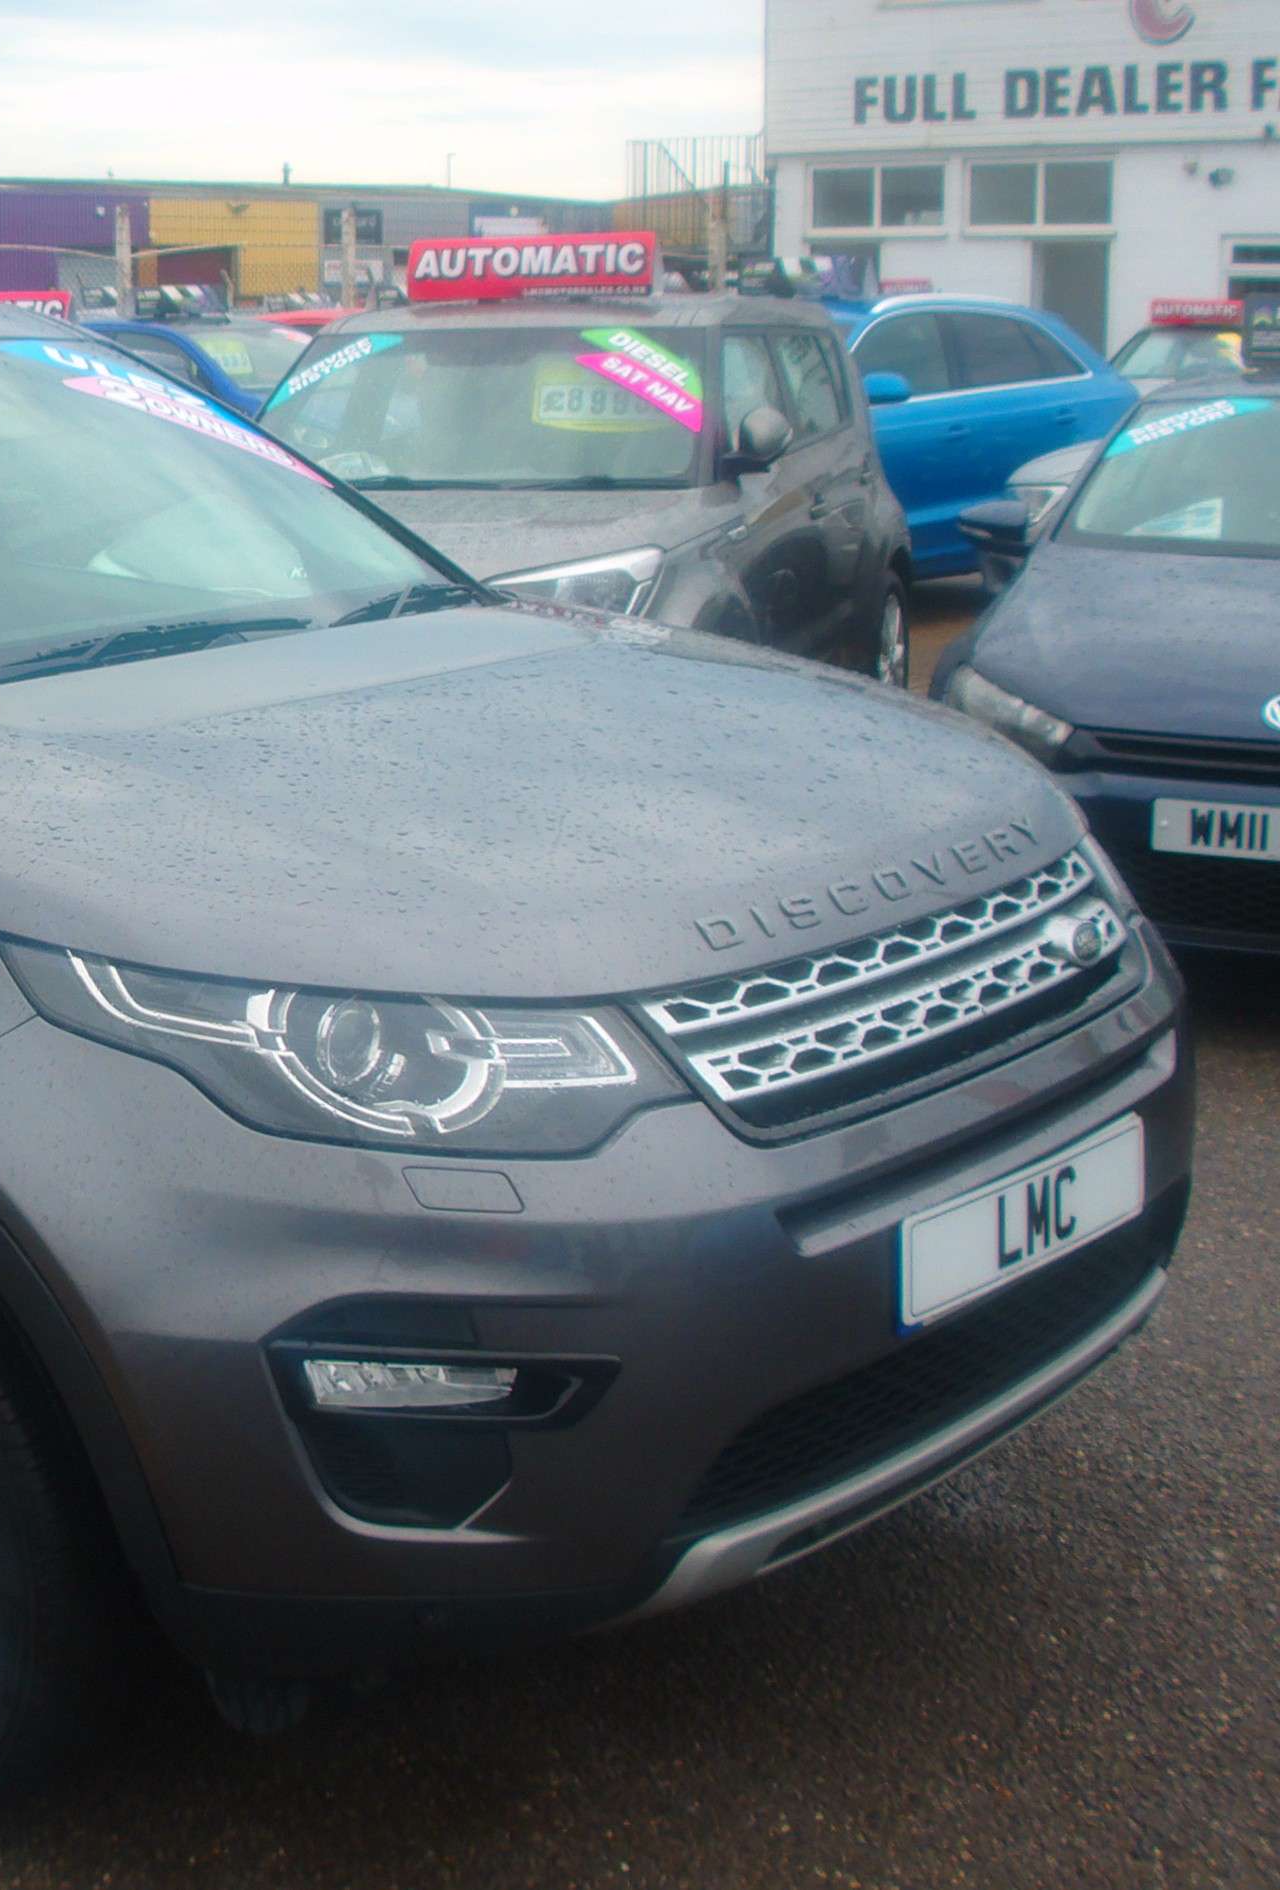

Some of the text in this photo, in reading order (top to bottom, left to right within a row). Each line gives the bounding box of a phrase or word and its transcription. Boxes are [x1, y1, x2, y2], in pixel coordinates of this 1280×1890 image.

[853, 57, 1280, 125] FULL DEALER F
[414, 241, 646, 279] AUTOMATIC
[1154, 303, 1239, 318] AUTOMATIC
[601, 356, 696, 413] SAT NAV
[608, 331, 689, 387] DIESEL
[694, 817, 1040, 951] DISCOVERY
[997, 1165, 1077, 1269] LMC
